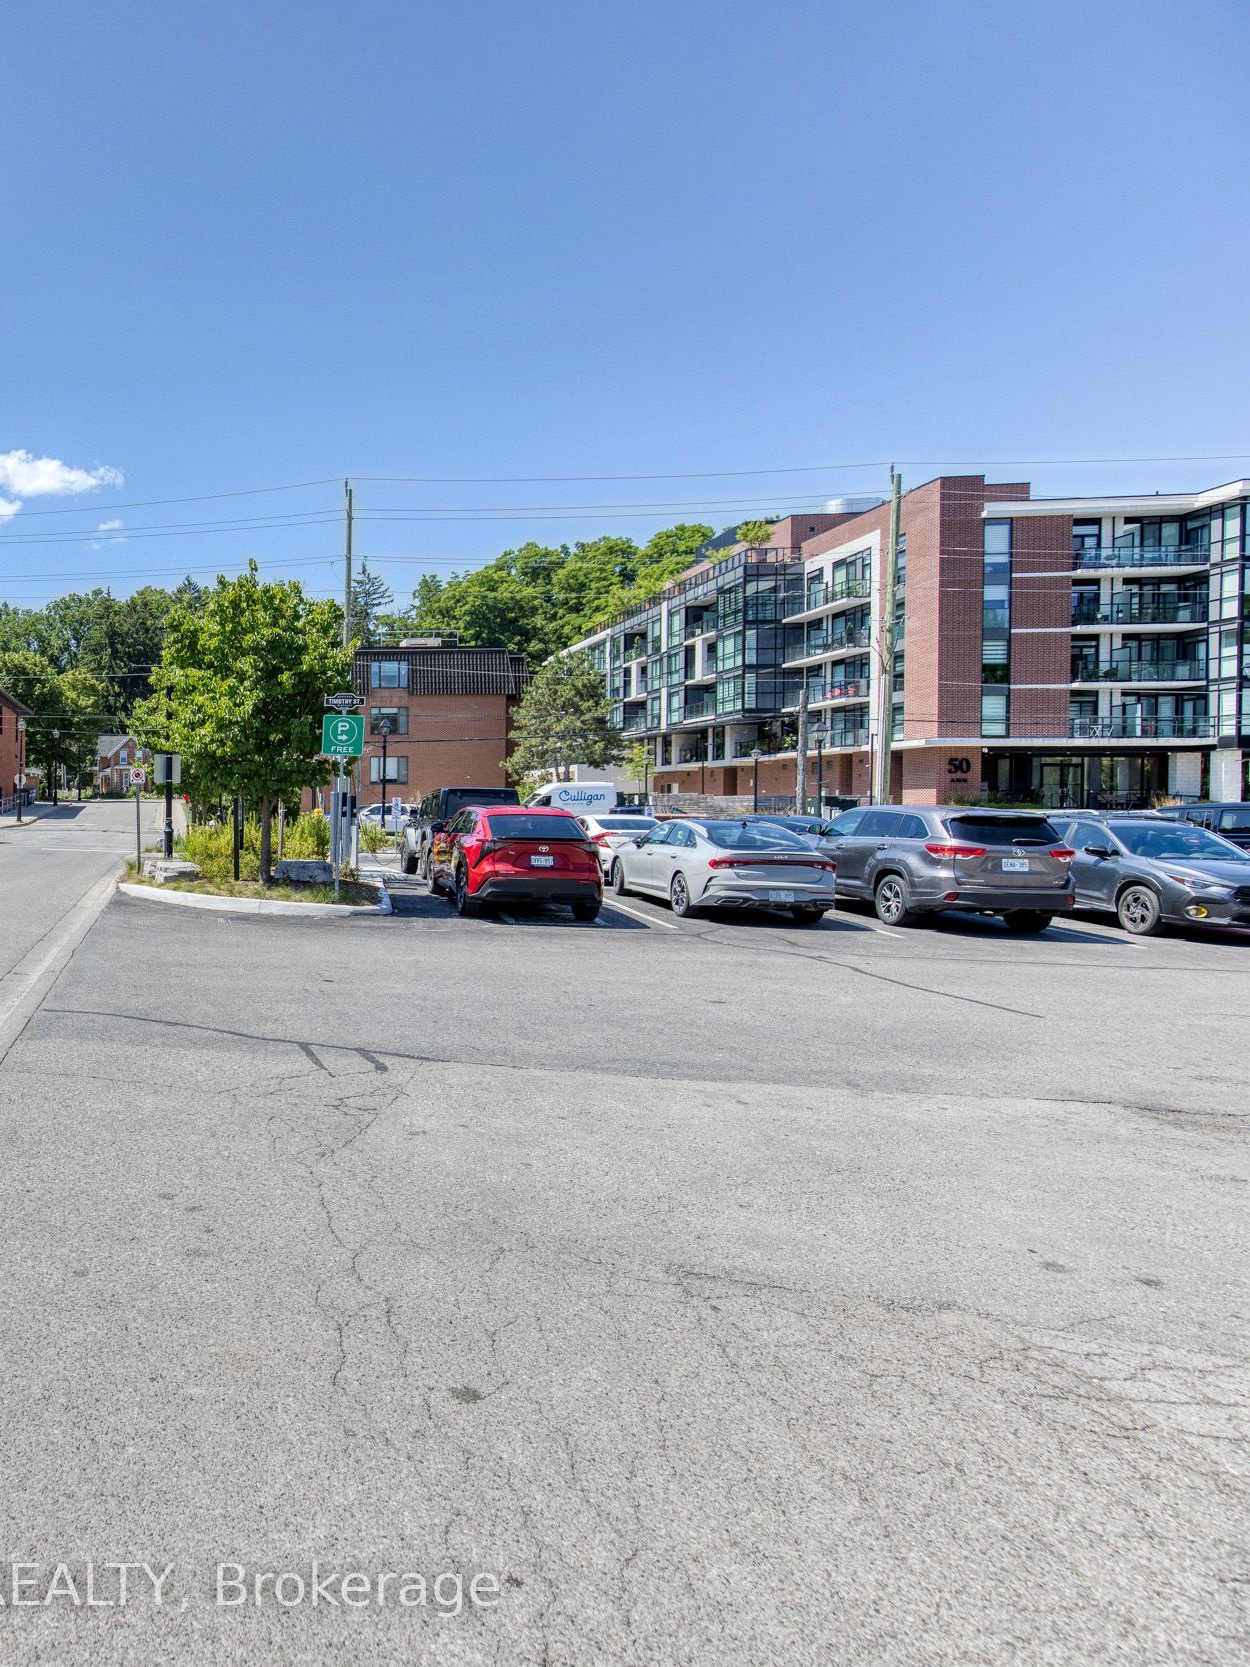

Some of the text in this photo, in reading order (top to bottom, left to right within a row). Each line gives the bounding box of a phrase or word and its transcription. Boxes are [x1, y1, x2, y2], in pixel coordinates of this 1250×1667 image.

[338, 722, 350, 735] P
[947, 757, 971, 774] 50
[559, 790, 606, 806] Culligan
